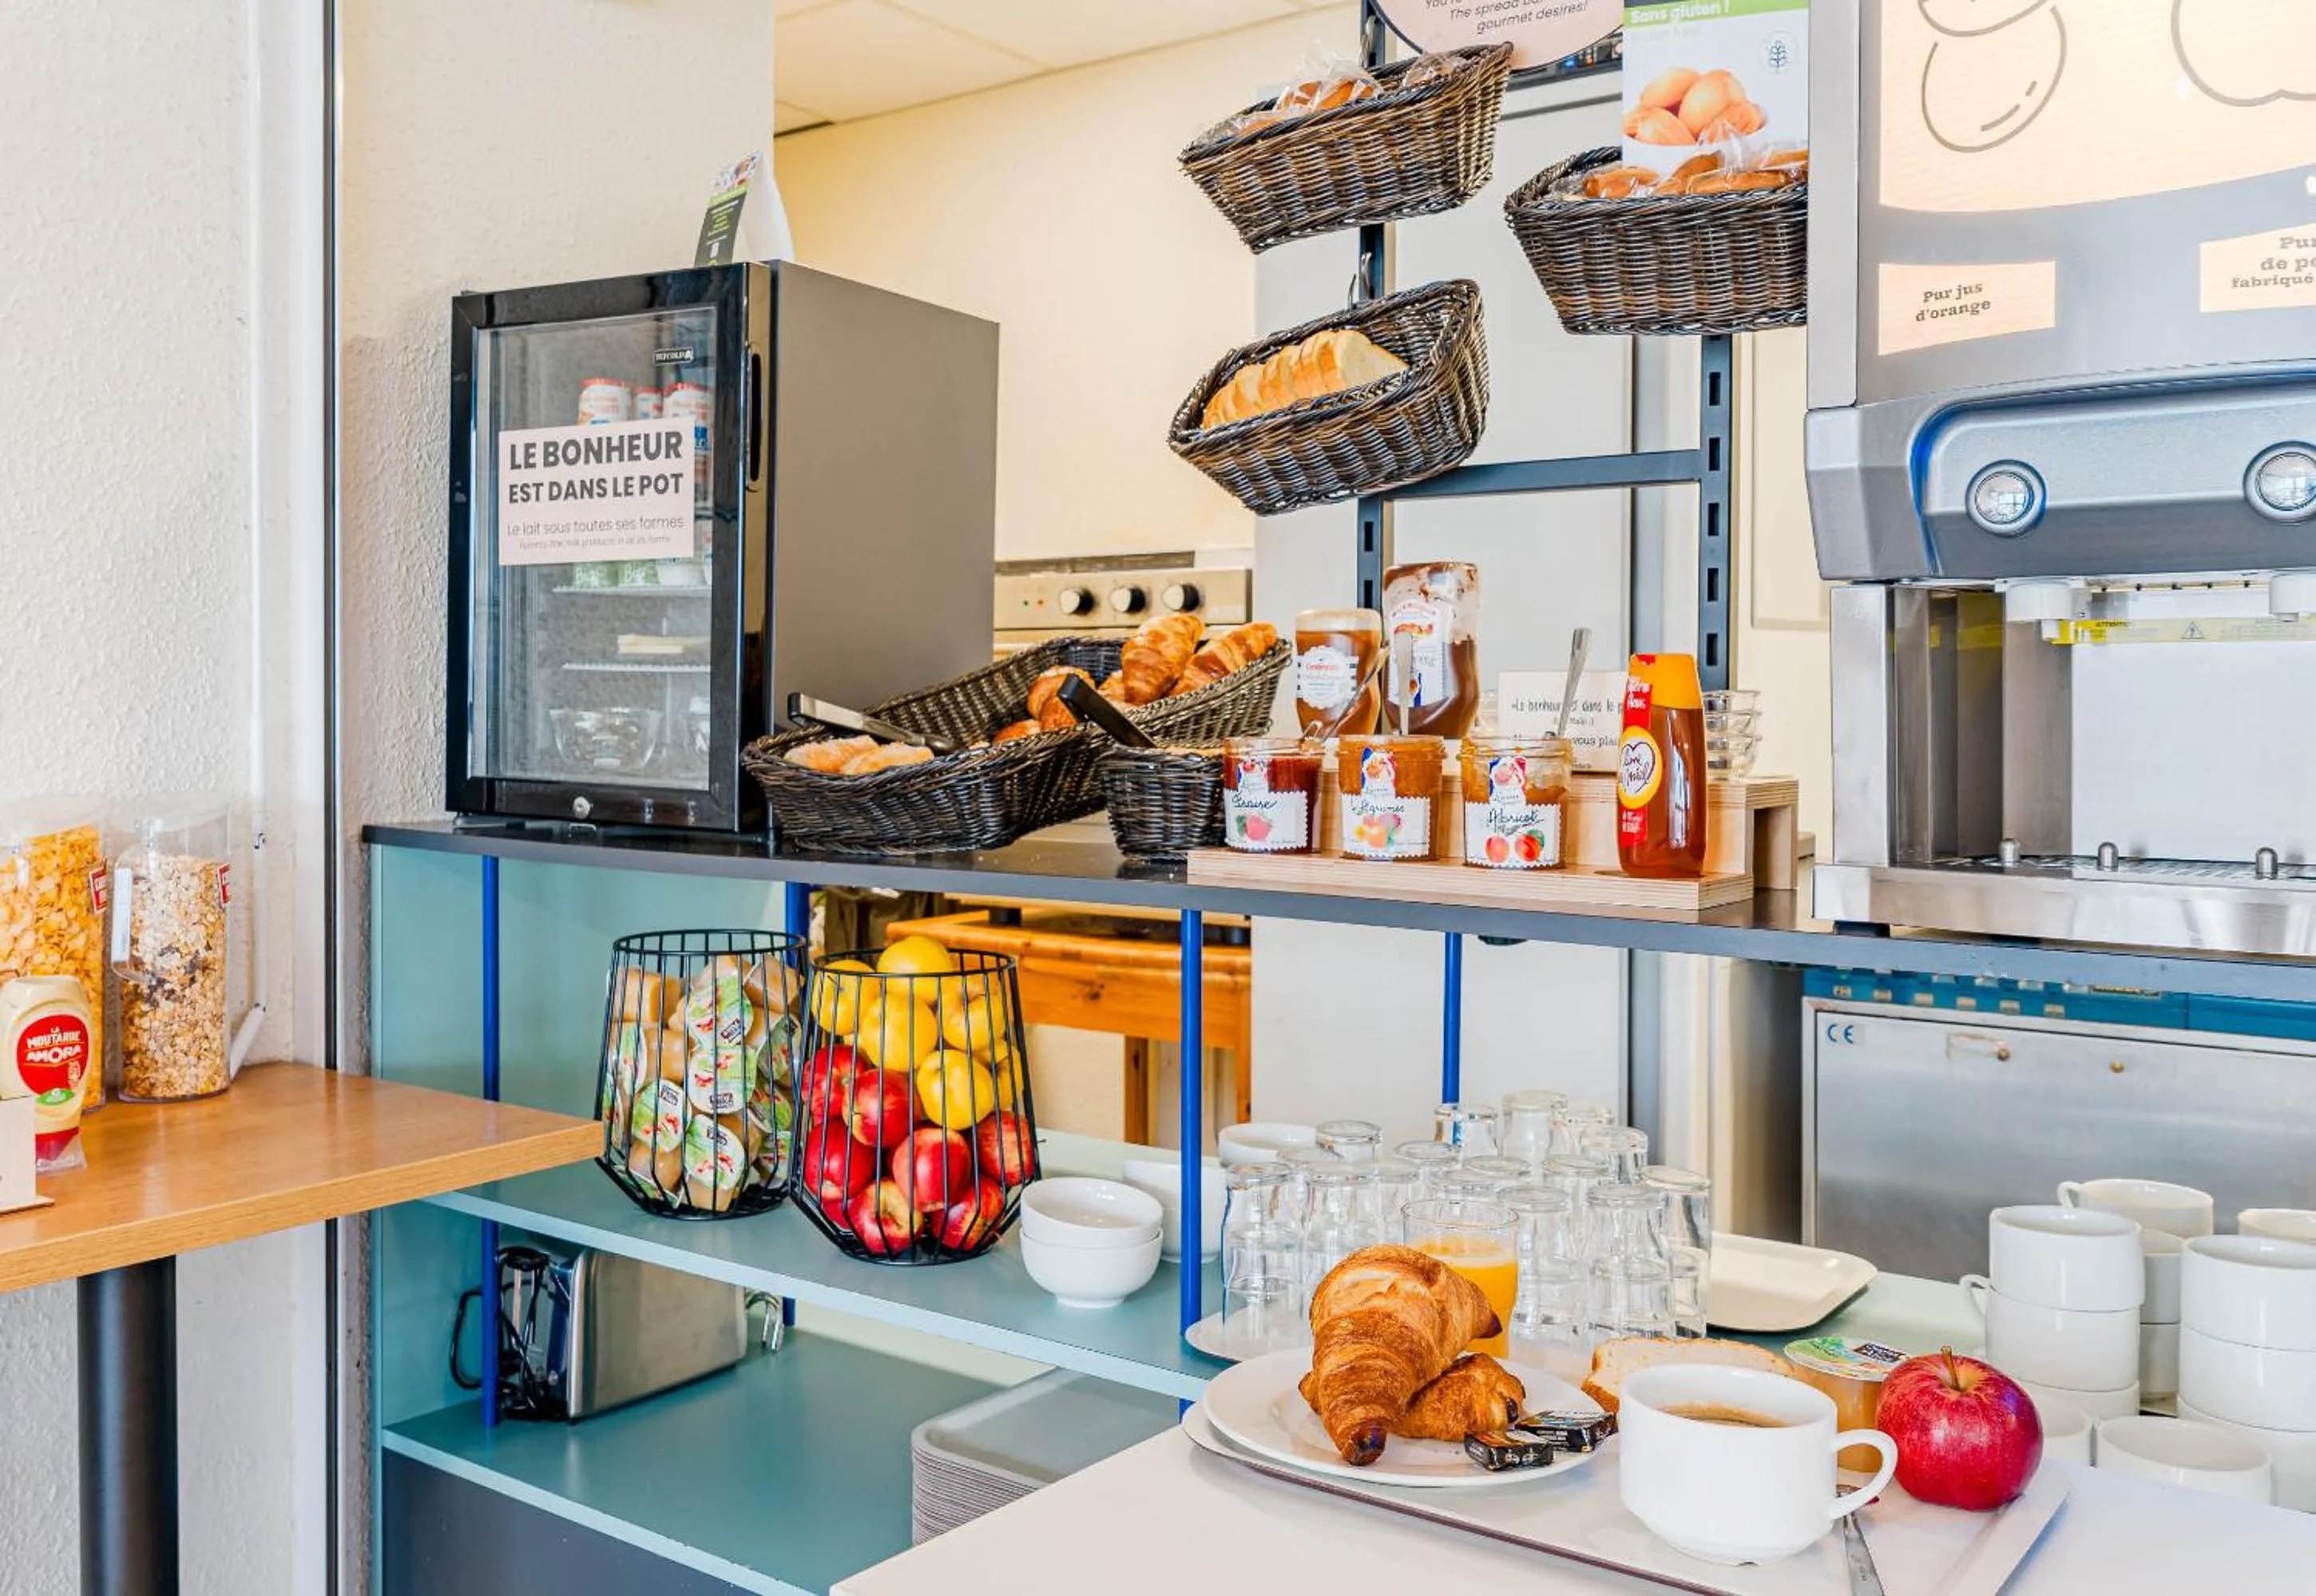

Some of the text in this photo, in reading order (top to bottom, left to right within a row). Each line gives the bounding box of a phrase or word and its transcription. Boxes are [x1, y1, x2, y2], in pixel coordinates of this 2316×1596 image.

[1450, 8, 1471, 20] The
[1477, 11, 1533, 34] gourmet
[1631, 8, 1668, 24] Sans
[2260, 257, 2288, 271] de
[2231, 272, 2314, 288] fabriqué
[1922, 283, 1984, 303] Pur jus
[1915, 300, 1992, 322] d'orange
[510, 442, 537, 470] LE
[543, 431, 683, 469] BONHEUR
[509, 472, 684, 504] EST DANS LE POT
[507, 515, 686, 537] Le lait sous toutes ses formes
[1529, 697, 1561, 712] bonheu
[26, 1030, 81, 1049] MOUTARDE
[1827, 1024, 1854, 1044] CE
[26, 1045, 81, 1063] AMORA
